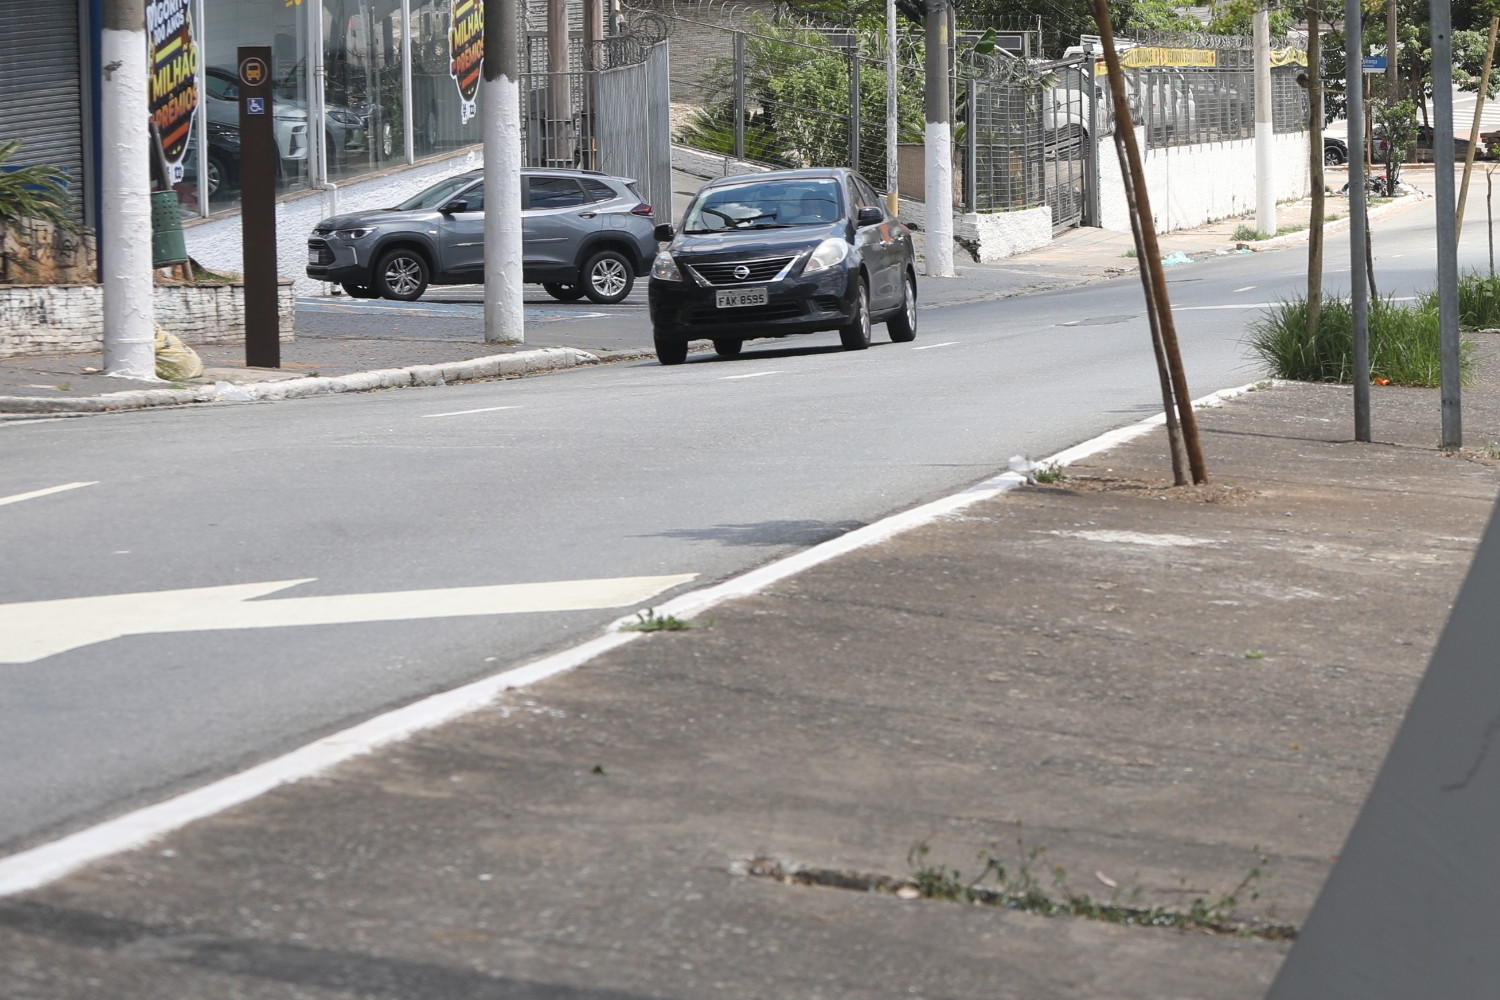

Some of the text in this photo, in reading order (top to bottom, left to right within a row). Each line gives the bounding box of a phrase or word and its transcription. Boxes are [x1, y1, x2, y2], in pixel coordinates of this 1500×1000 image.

[166, 9, 184, 37] ANOS
[153, 43, 198, 102] MILHÃO
[155, 82, 199, 128] PRÊMIOS
